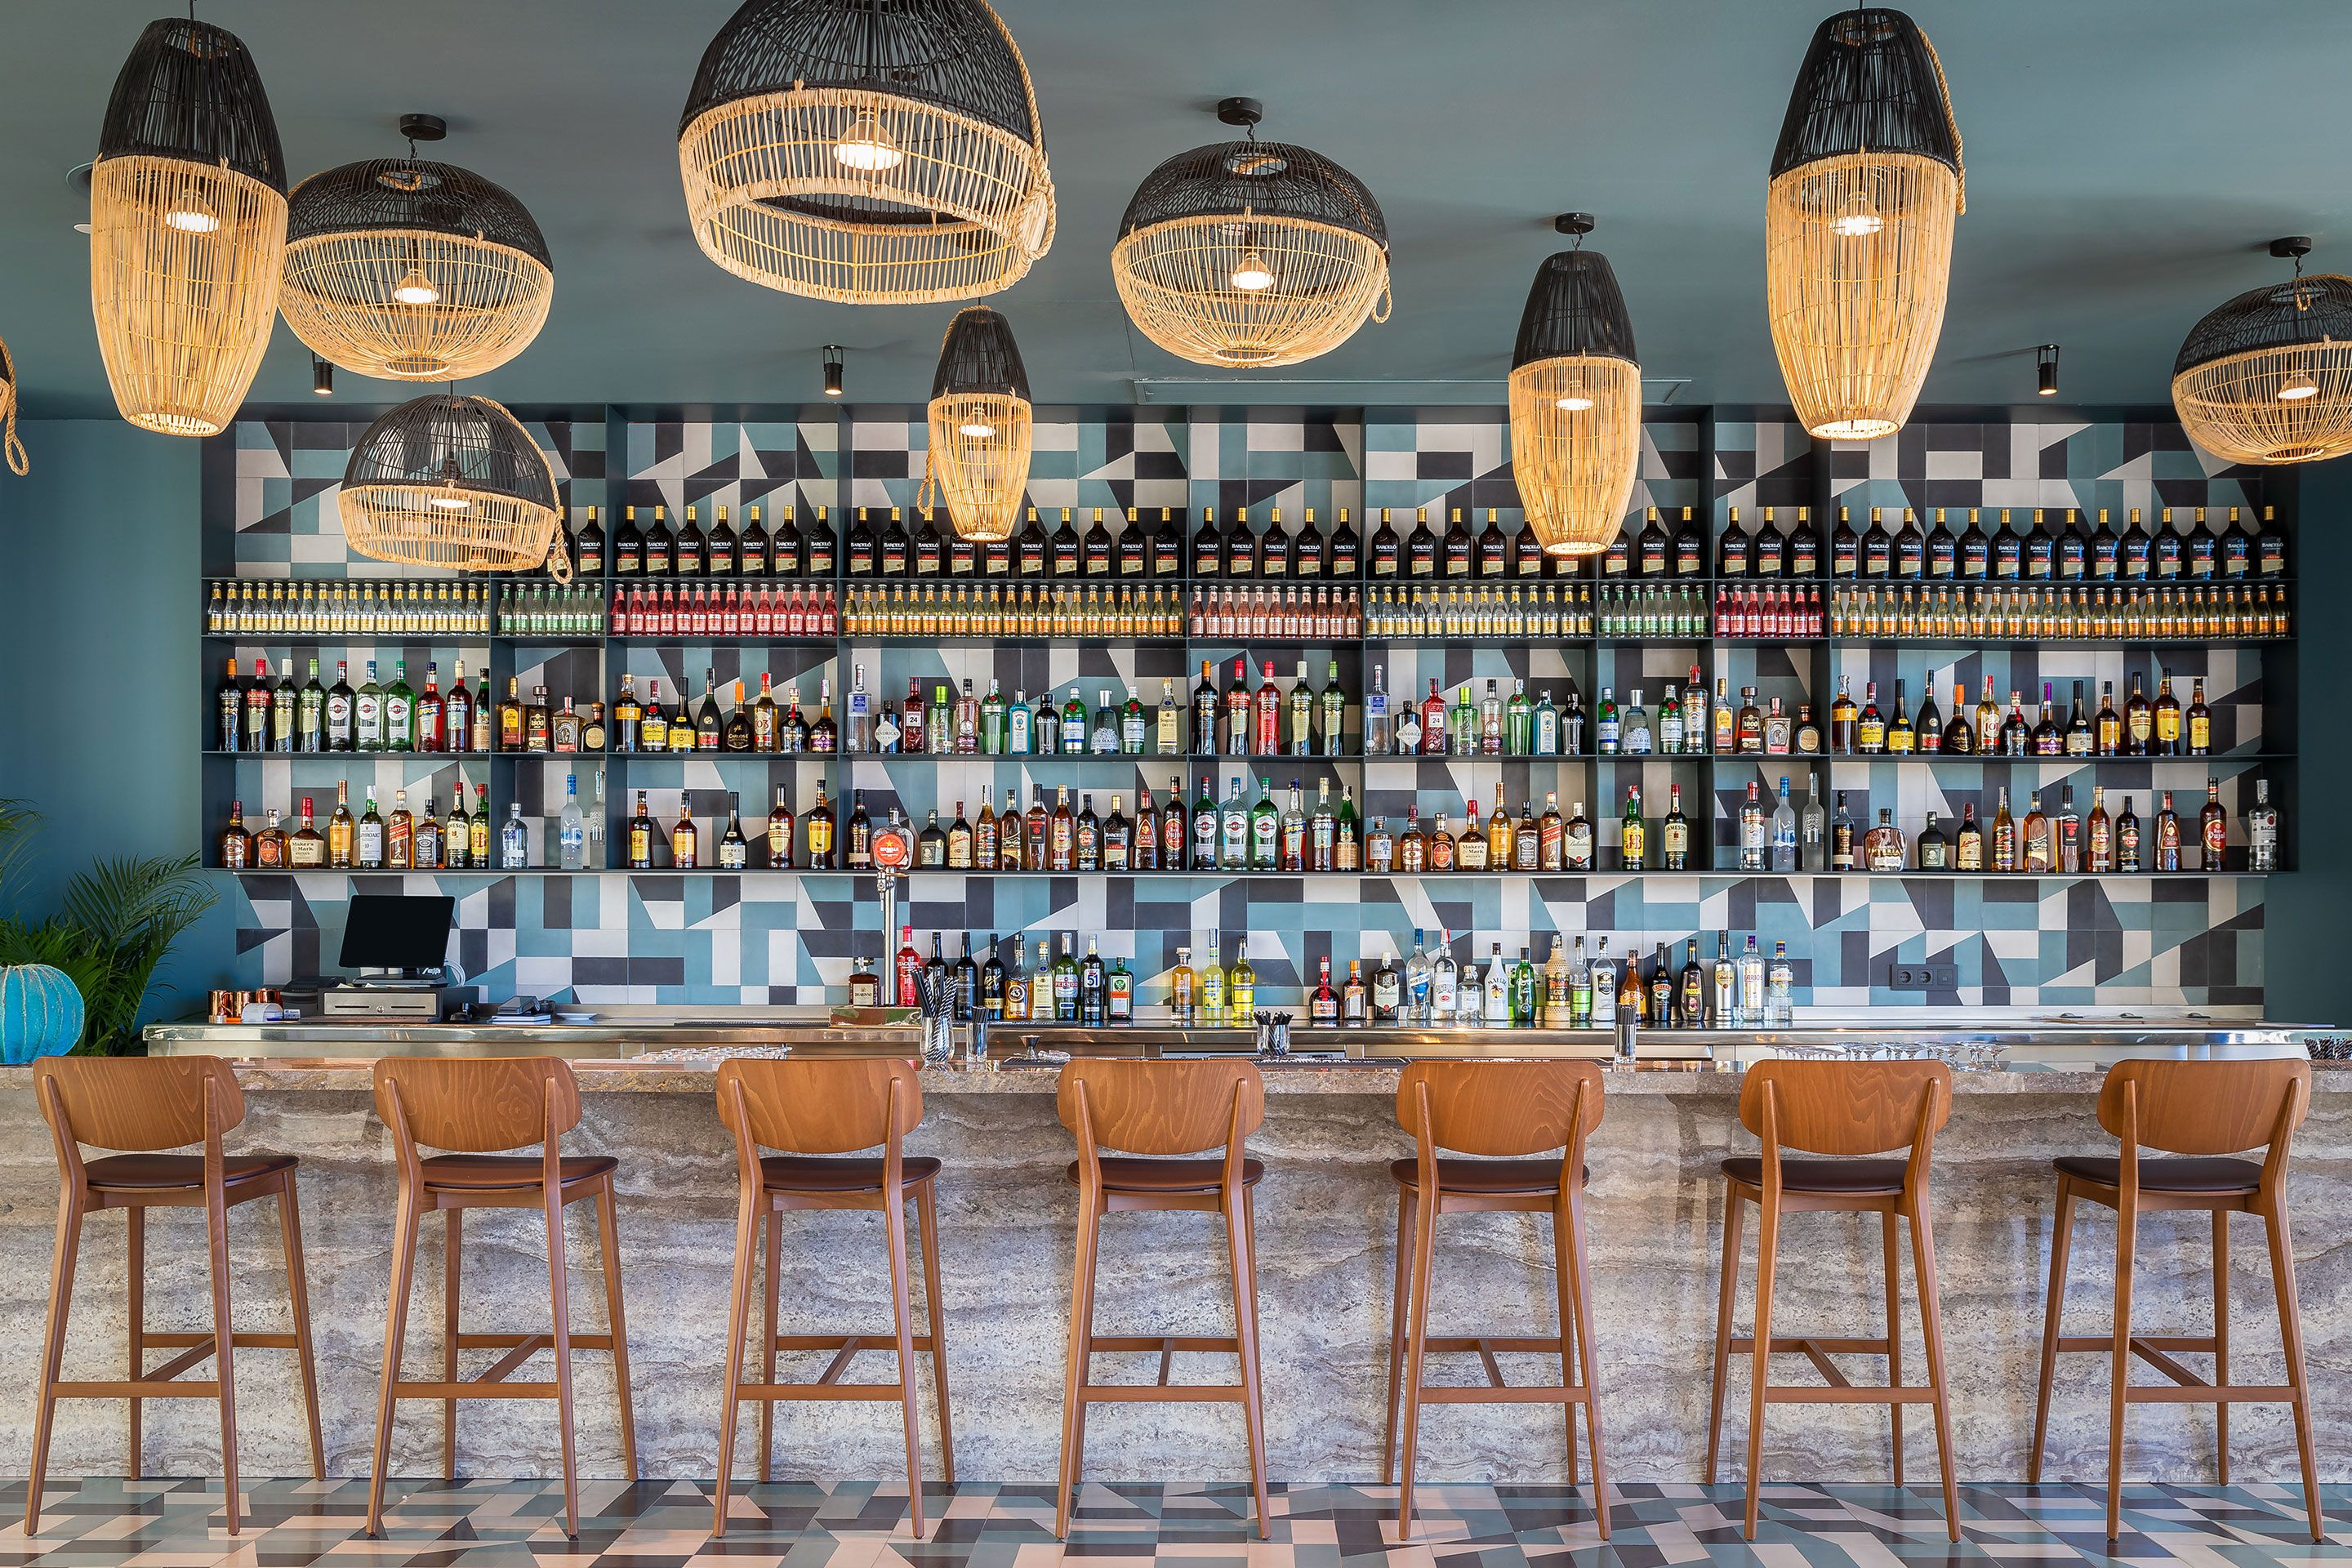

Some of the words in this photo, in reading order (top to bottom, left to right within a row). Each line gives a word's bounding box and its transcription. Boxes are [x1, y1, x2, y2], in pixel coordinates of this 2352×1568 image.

[1285, 825, 1305, 834] APEROL
[2207, 832, 2225, 840] Pujol
[1087, 973, 1098, 987] 51
[1010, 989, 1021, 997] 43
